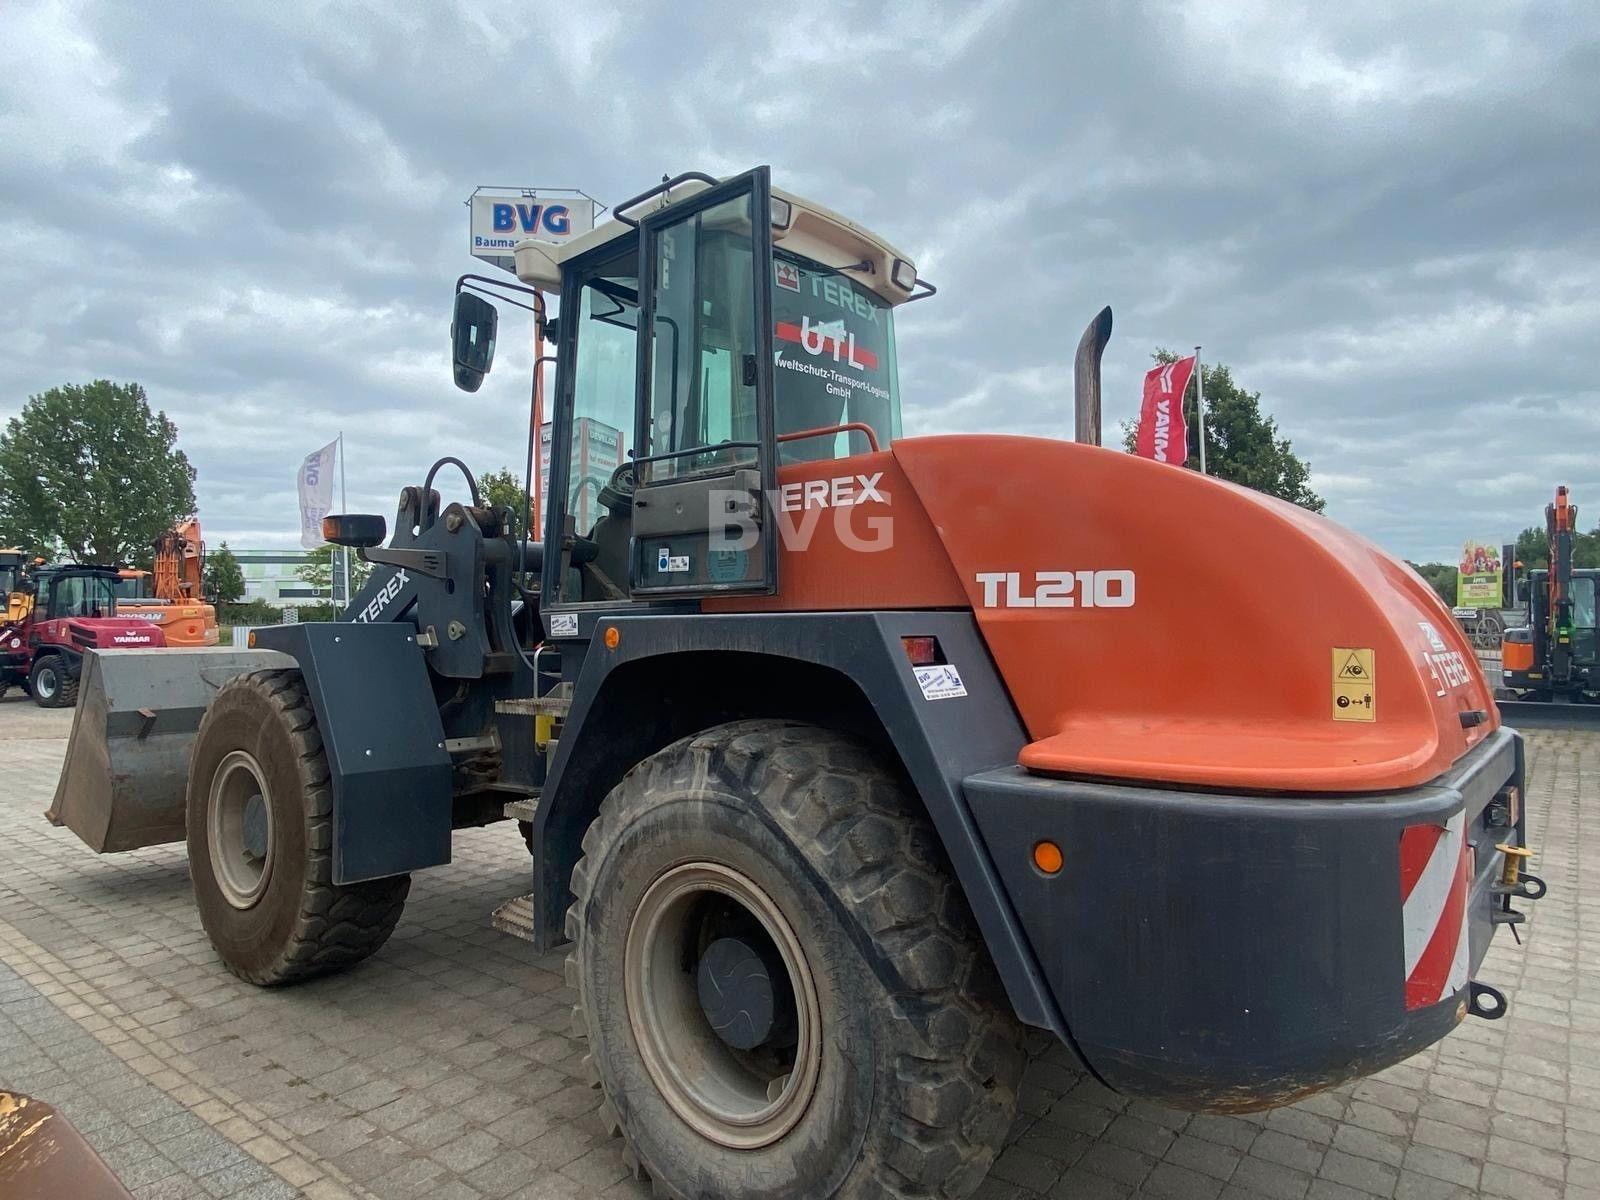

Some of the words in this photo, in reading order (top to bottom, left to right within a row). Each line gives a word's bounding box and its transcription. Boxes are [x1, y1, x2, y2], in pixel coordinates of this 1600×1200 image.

[493, 203, 571, 235] BVG
[811, 276, 879, 325] TEREX
[801, 315, 865, 370] UTL
[825, 382, 851, 399] GmbH
[780, 472, 885, 512] EREX
[359, 568, 410, 623] TEREX
[976, 569, 1136, 608] TL210
